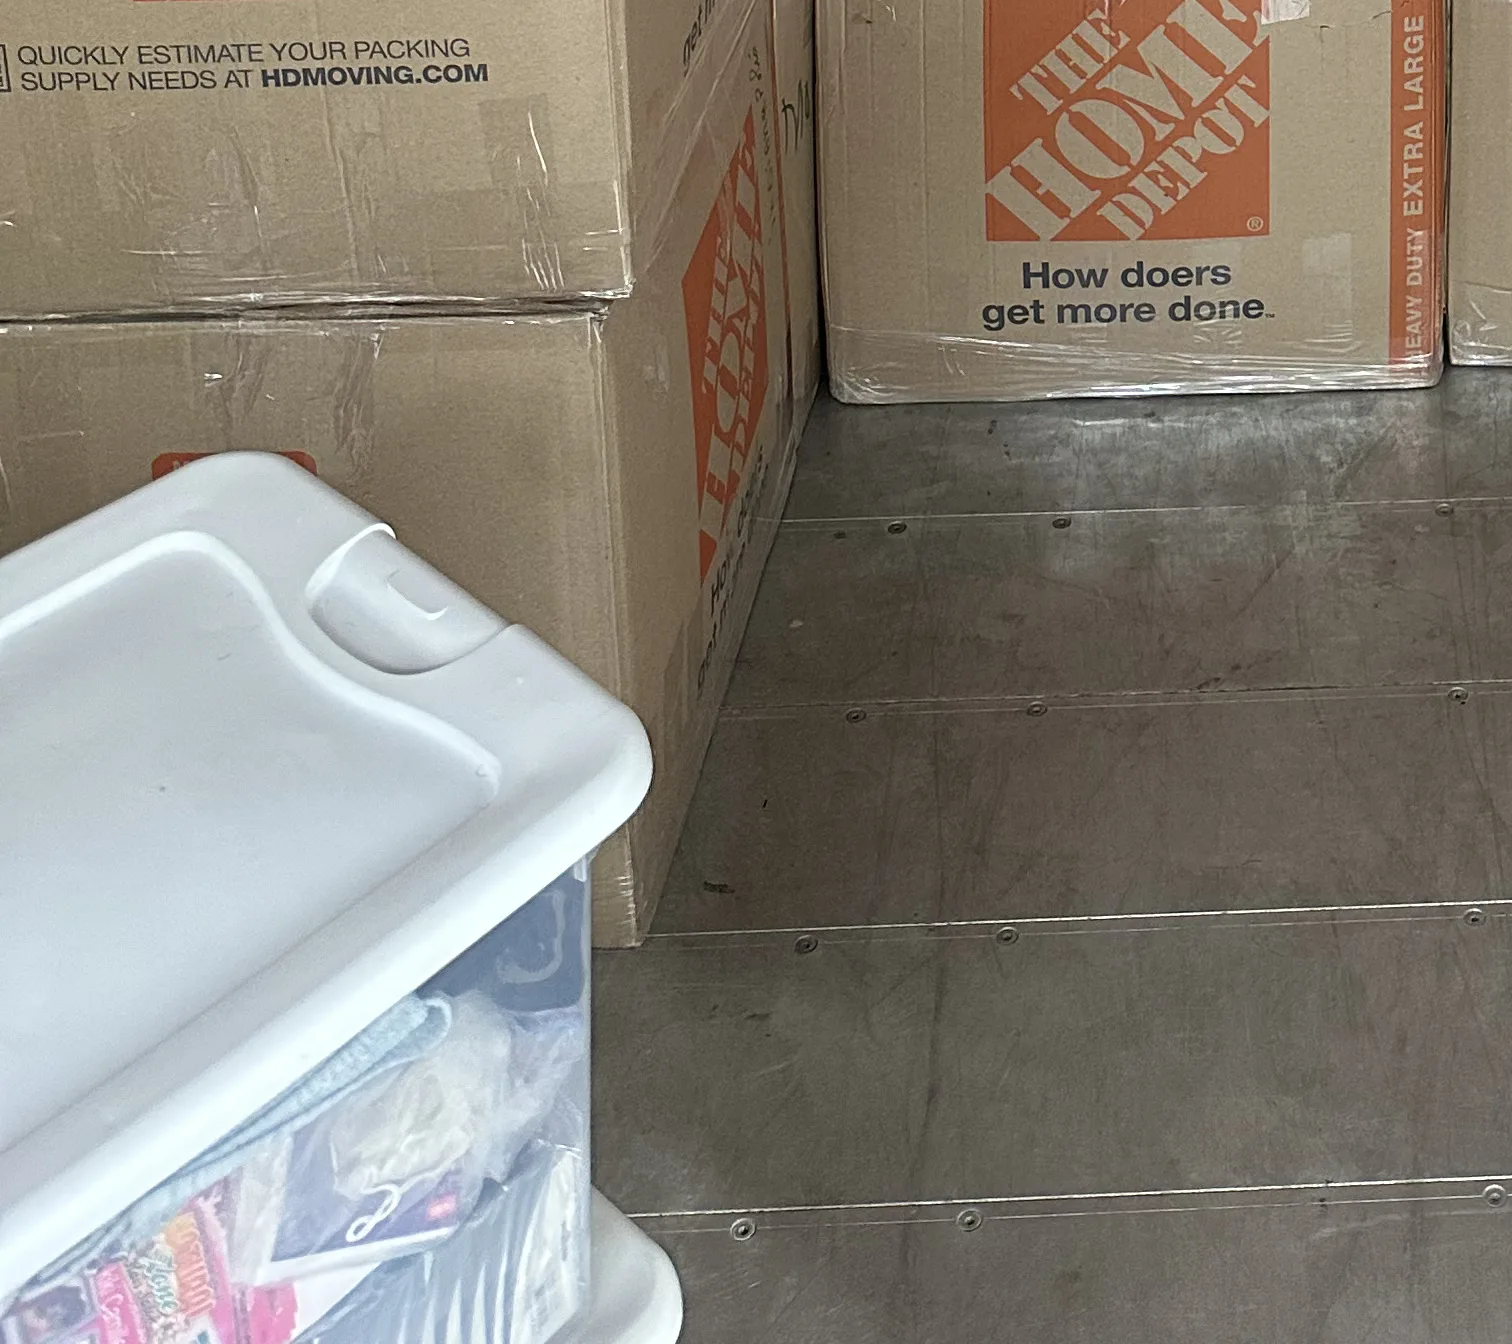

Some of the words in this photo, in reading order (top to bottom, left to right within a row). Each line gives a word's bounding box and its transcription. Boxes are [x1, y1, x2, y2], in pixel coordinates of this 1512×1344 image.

[18, 46, 128, 66] QUICKLY
[138, 43, 263, 64] ESTIMATE
[270, 41, 347, 62] YOUR
[354, 39, 471, 61] PACKING
[21, 70, 122, 92] SUPPLY
[128, 68, 218, 90] NEEDS
[223, 68, 255, 88] AT
[261, 64, 489, 88] HDMOVING.COM
[1009, 4, 1130, 111] THE
[1404, 15, 1424, 112] LARGE
[1097, 74, 1265, 238] DEPOT
[1404, 121, 1424, 216] EXTRA
[1022, 262, 1109, 289] How
[1121, 260, 1231, 288] doers
[1407, 228, 1424, 286] DUTY
[982, 300, 1044, 331] get
[1057, 300, 1156, 324] more
